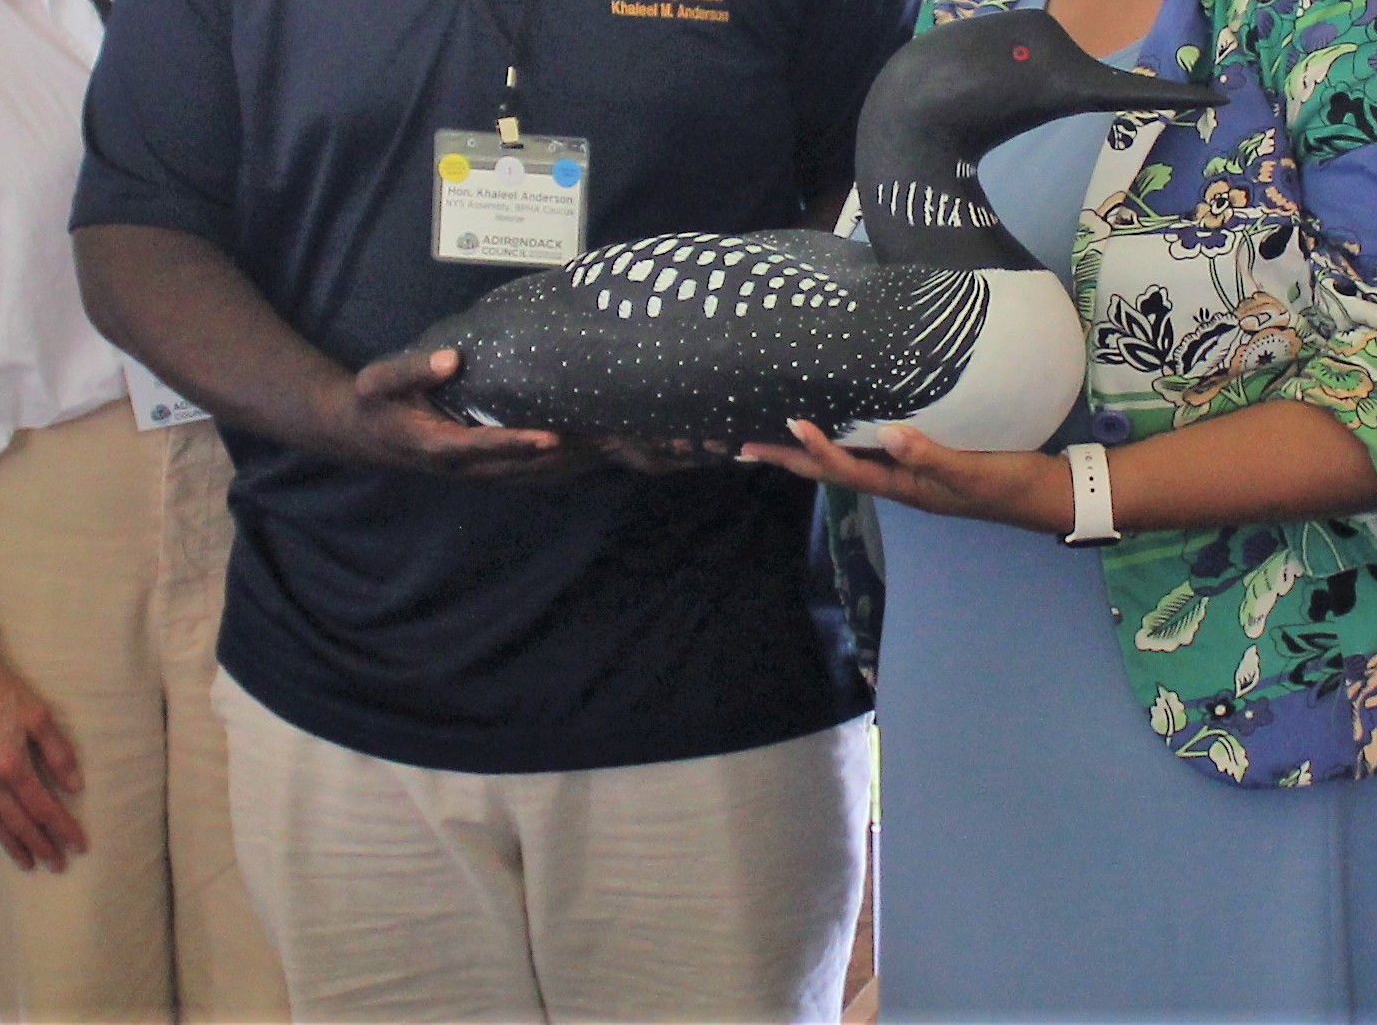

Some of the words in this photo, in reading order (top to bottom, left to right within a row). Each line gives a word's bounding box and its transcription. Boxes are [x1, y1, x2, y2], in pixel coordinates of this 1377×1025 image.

[611, 0, 657, 16] Khaleel
[677, 3, 729, 22] Anderson
[448, 187, 472, 197] Hon.
[477, 189, 517, 199] Khaleel
[520, 192, 573, 204] Anderson
[483, 235, 563, 249] ADIRONDACK
[482, 248, 525, 258] COUNCIL
